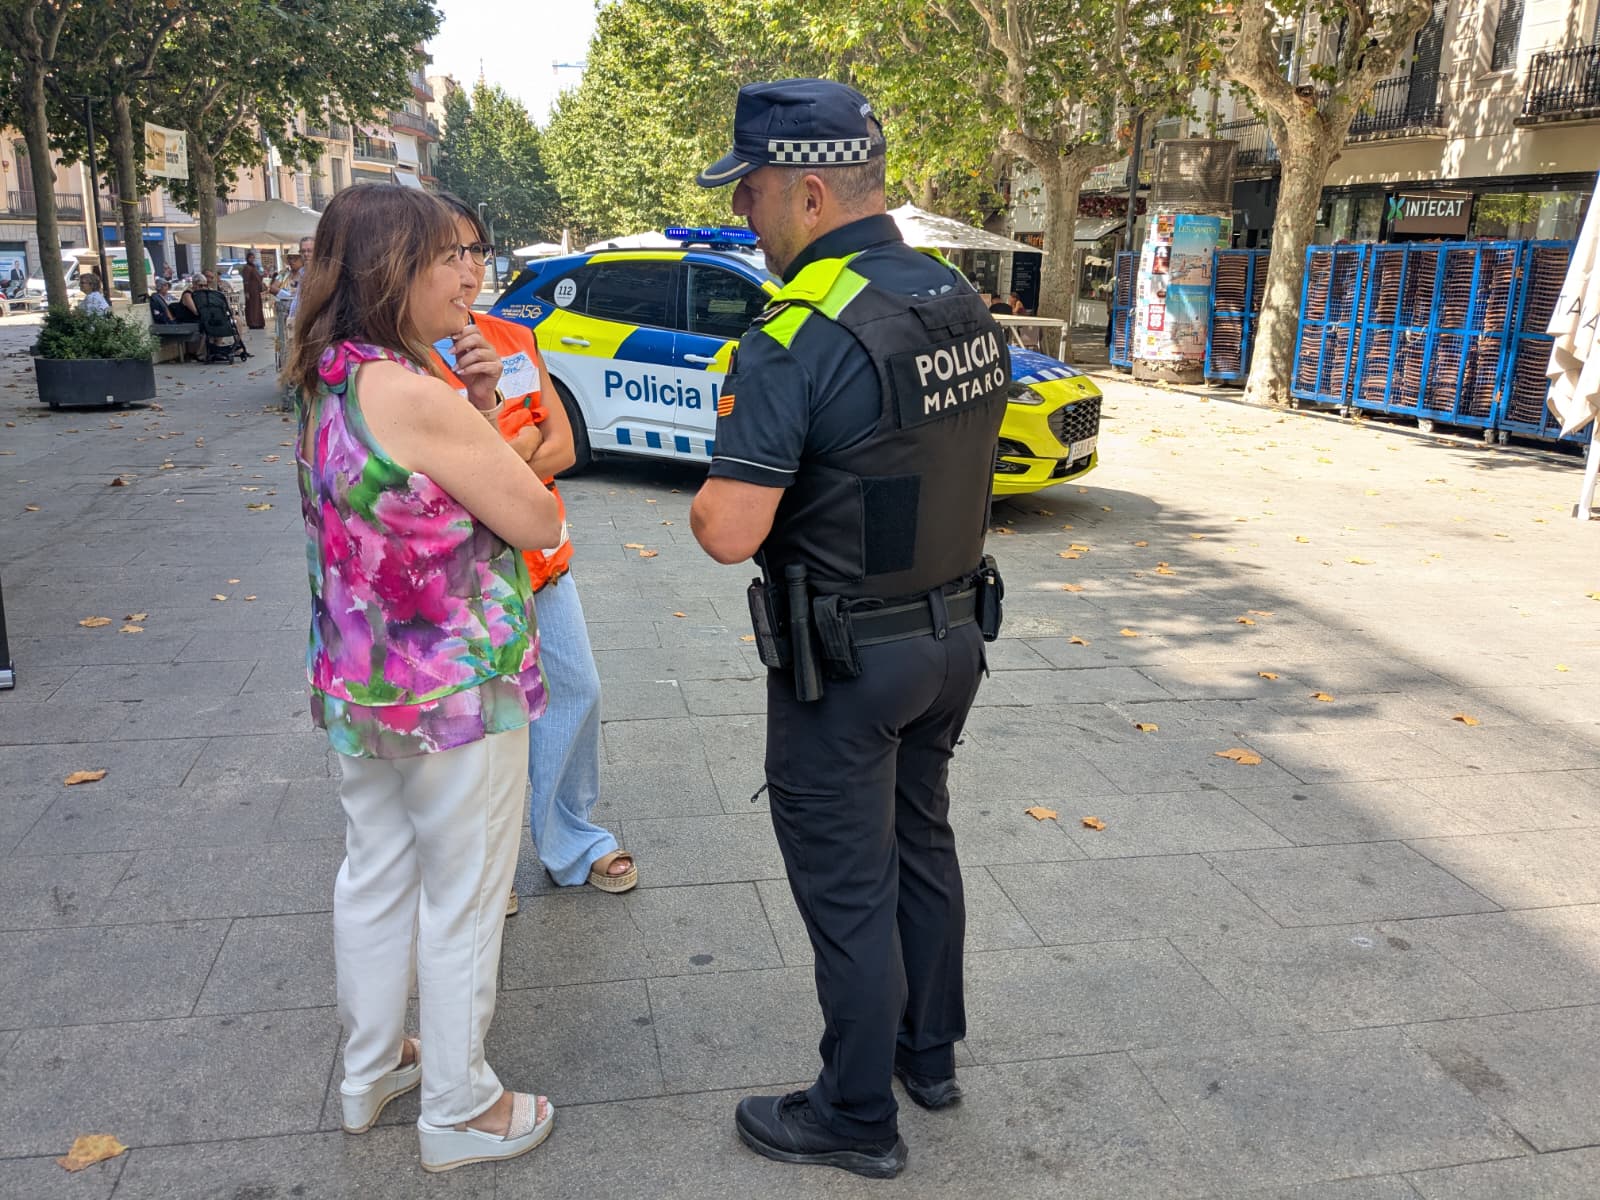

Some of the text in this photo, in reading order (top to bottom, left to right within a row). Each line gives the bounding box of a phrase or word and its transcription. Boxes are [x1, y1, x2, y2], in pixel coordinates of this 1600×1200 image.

[558, 286, 573, 297] 112
[915, 331, 1000, 387] POLICIA
[604, 370, 702, 409] Policia
[923, 362, 1005, 415] MATARÓ
